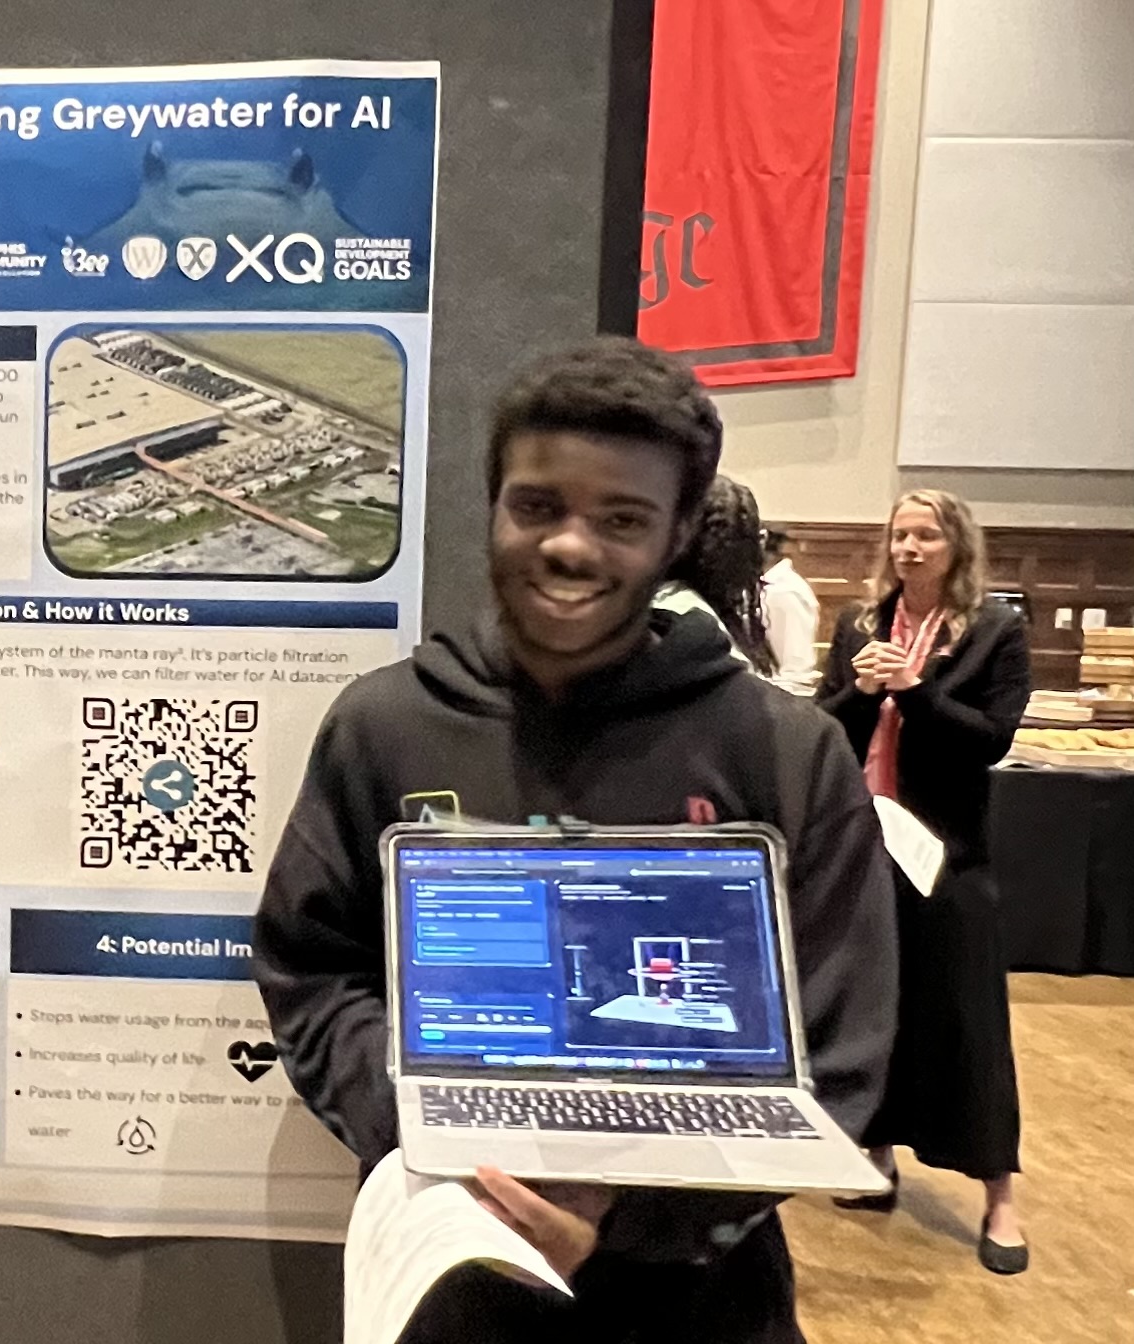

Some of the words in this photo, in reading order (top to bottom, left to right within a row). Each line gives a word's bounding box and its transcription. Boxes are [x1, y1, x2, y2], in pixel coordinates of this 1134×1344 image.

[52, 94, 273, 142] Greywater
[281, 93, 340, 130] for
[350, 98, 391, 130] AI
[335, 238, 411, 249] SUSTAINABLE
[226, 232, 325, 284] XQ
[335, 249, 409, 260] DEVELOPMENT
[333, 260, 411, 281] GOALS
[0, 491, 24, 506] the
[22, 601, 39, 620] &
[45, 601, 94, 621] How
[98, 601, 114, 621] it
[119, 602, 190, 622] Works
[69, 646, 95, 660] the
[99, 647, 149, 661] manta
[218, 648, 278, 665] particle
[283, 649, 348, 663] filtration
[25, 664, 54, 678] This
[96, 668, 117, 680] we
[121, 668, 150, 681] can
[154, 666, 191, 681] filter
[195, 668, 239, 682] water
[243, 669, 265, 682] for
[269, 669, 285, 682] AI
[96, 935, 117, 954] 4:
[121, 935, 220, 957] Potential
[225, 939, 253, 958] Im
[30, 1009, 73, 1025] Stops
[78, 1012, 121, 1025] water
[125, 1015, 170, 1030] usage
[174, 1014, 213, 1029] from
[215, 1015, 241, 1029] the
[29, 1048, 102, 1063] Increases
[106, 1050, 157, 1067] quality
[161, 1052, 178, 1065] of
[29, 1086, 72, 1101] Paves
[76, 1087, 102, 1102] the
[105, 1090, 135, 1105] way
[140, 1089, 163, 1103] for
[167, 1093, 175, 1104] a
[179, 1091, 226, 1106] better
[231, 1094, 261, 1107] way
[266, 1095, 283, 1107] to
[28, 1124, 71, 1138] water
